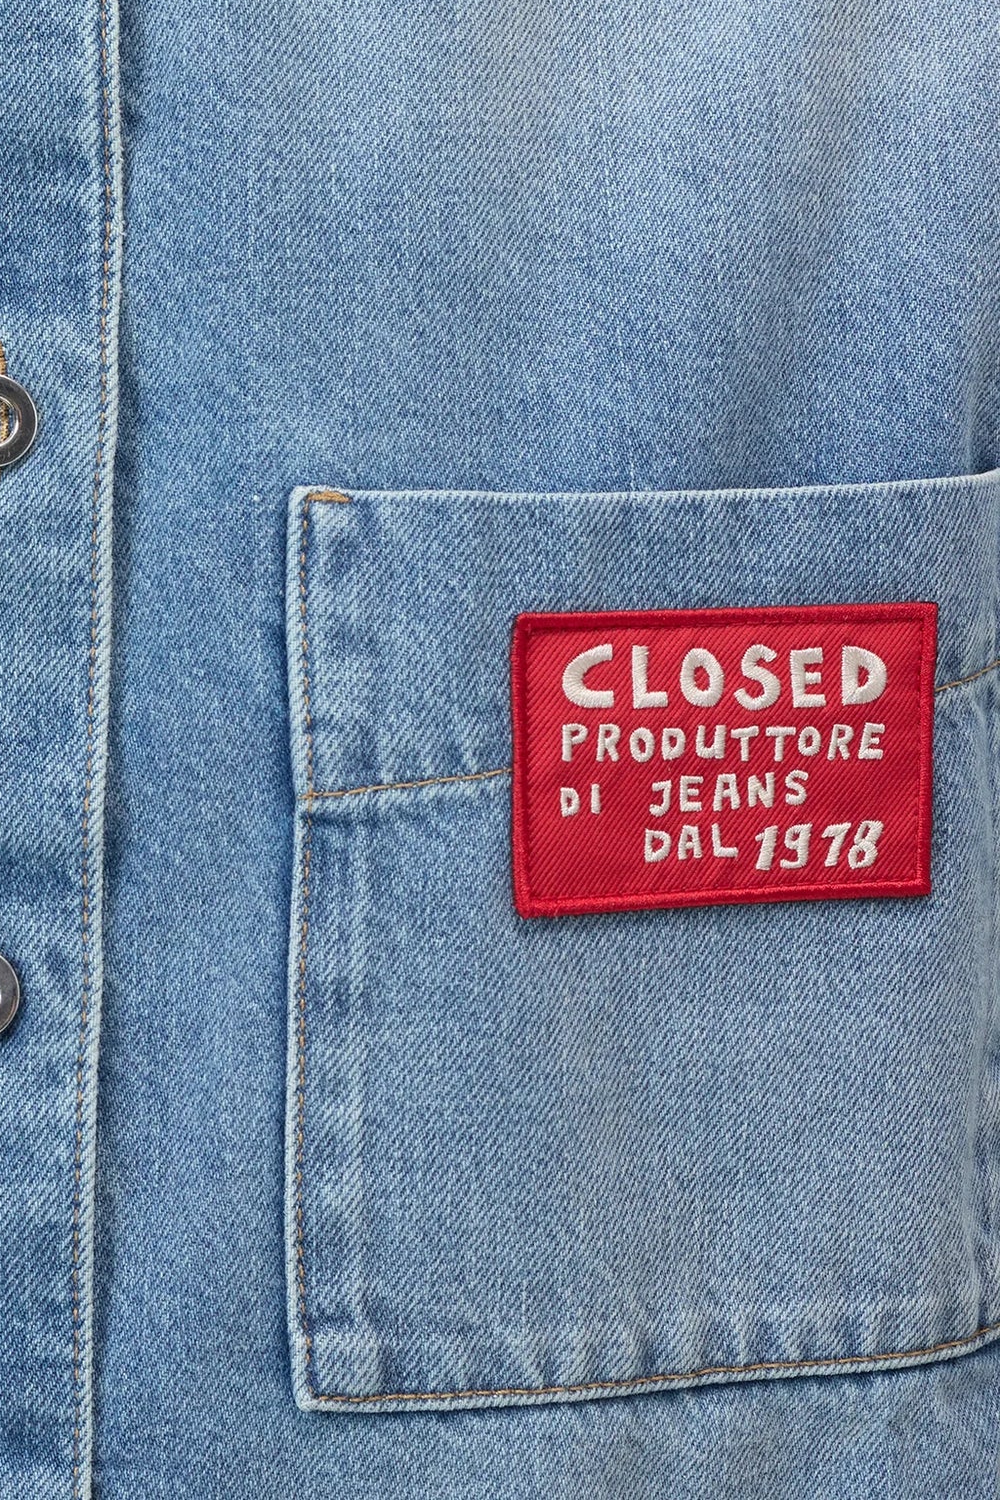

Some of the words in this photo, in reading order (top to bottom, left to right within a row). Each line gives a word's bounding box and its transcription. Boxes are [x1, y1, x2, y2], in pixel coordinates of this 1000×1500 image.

[561, 643, 888, 712] CLOSED
[561, 721, 886, 764] PRODUTTORE
[560, 783, 602, 818] DI
[649, 769, 809, 818] JEANS
[643, 822, 739, 864] DAL
[755, 819, 885, 872] 1978
